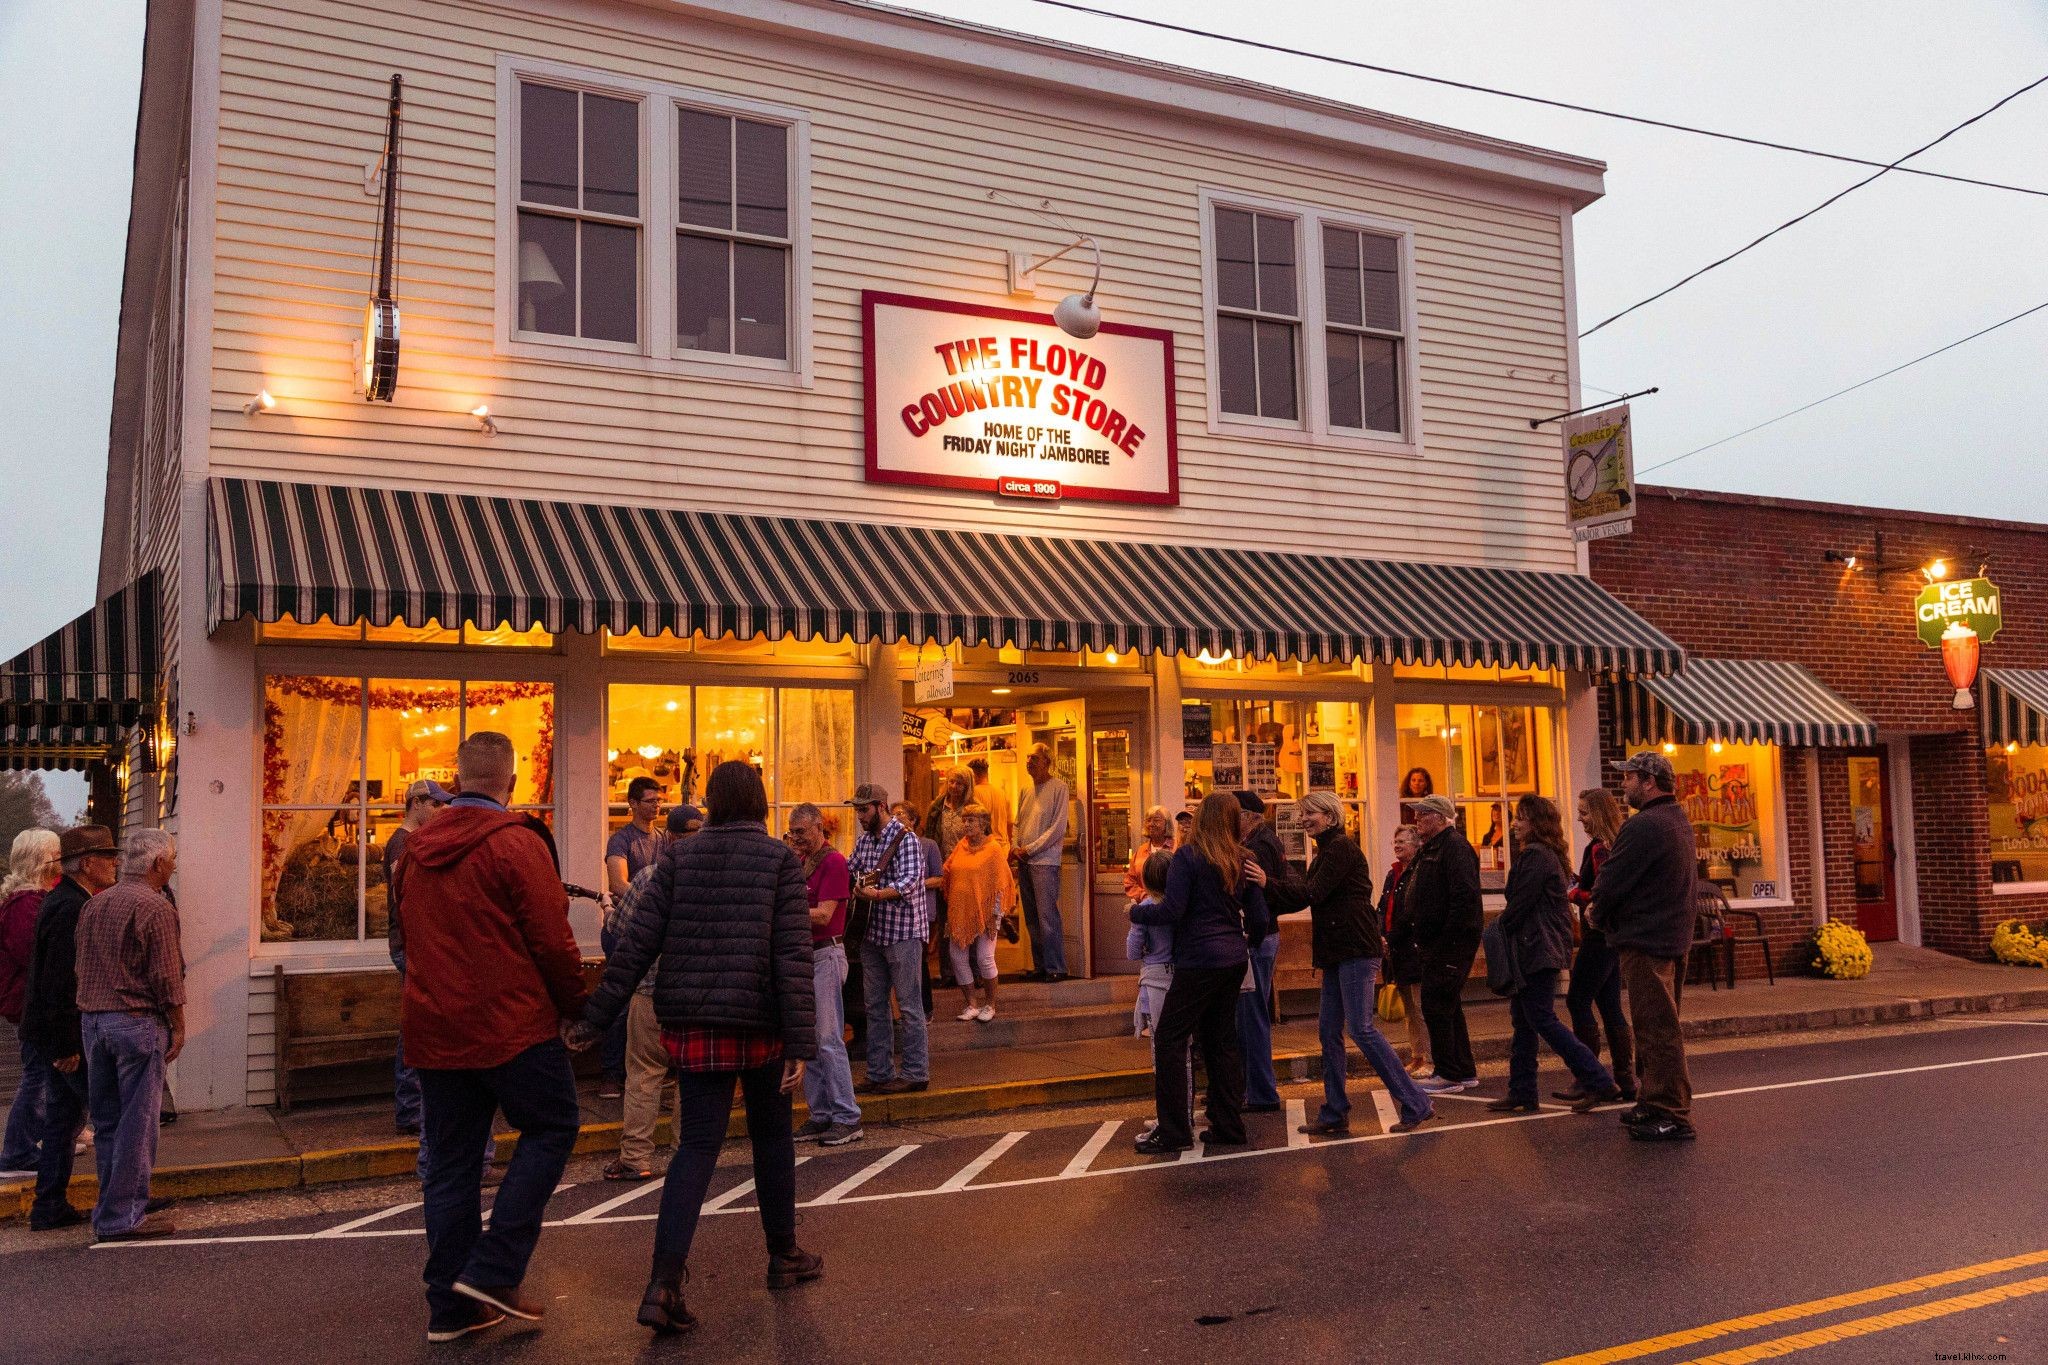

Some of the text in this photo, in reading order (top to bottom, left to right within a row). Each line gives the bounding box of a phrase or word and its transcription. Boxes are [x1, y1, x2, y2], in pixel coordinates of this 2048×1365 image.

[935, 337, 1107, 391] THE FLOYD
[901, 375, 1146, 459] COUNTRY STORE
[984, 421, 1071, 445] HOME OF THE
[943, 434, 1110, 466] FRIDAY NIGHT JAMBOREE
[1005, 481, 1056, 495] circa 1909
[1602, 521, 1628, 538] VENUE
[1940, 582, 1973, 601] ICE
[1918, 596, 1998, 622] CREAM
[1008, 671, 1040, 684] 206S
[903, 714, 921, 726] EST
[903, 724, 922, 736] OMS
[1695, 845, 1731, 864] UNTRY
[1753, 883, 1775, 896] OPEN
